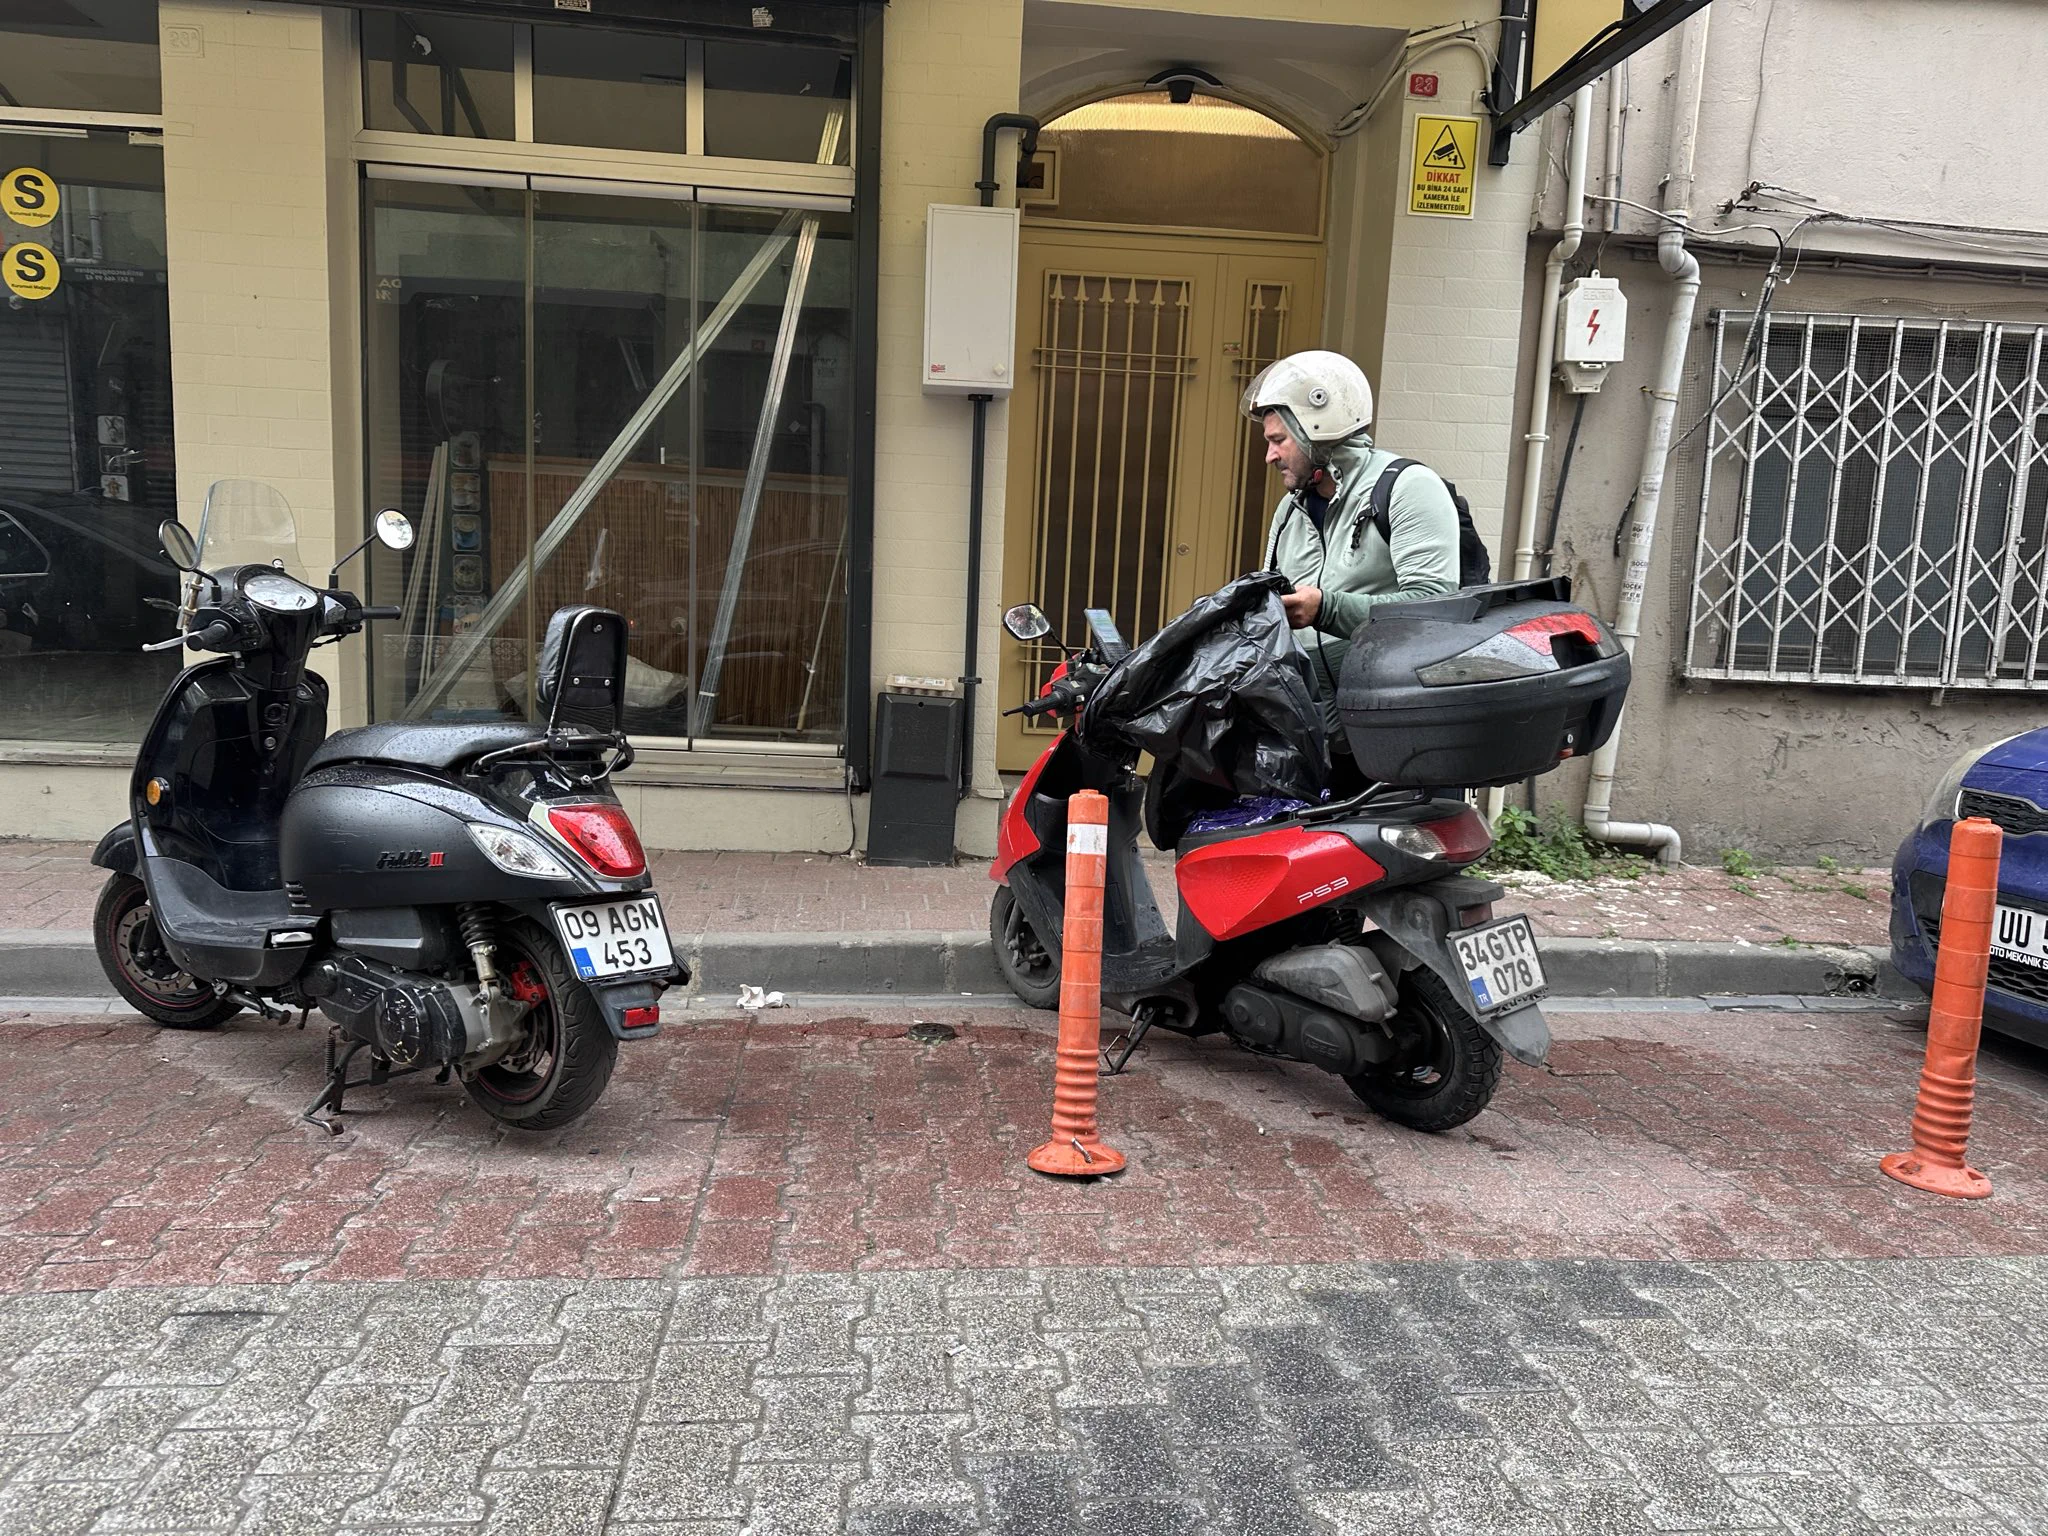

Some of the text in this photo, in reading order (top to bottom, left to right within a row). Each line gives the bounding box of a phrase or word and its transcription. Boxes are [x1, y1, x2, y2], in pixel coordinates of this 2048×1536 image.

[1414, 76, 1434, 93] 23
[1426, 169, 1461, 184] DİKKAT
[14, 174, 45, 209] S
[1427, 184, 1442, 192] BİNA
[1423, 193, 1461, 202] KAMERA İLE
[1416, 201, 1465, 211] İZLENMEKTEDİR
[16, 249, 46, 282] S
[1297, 876, 1349, 904] PS3
[564, 902, 659, 939] 09 AGN
[604, 937, 652, 968] 453
[1990, 945, 2005, 957] OTO
[581, 966, 594, 976] TR
[1493, 958, 1533, 996] 078
[1478, 993, 1489, 1004] TR
